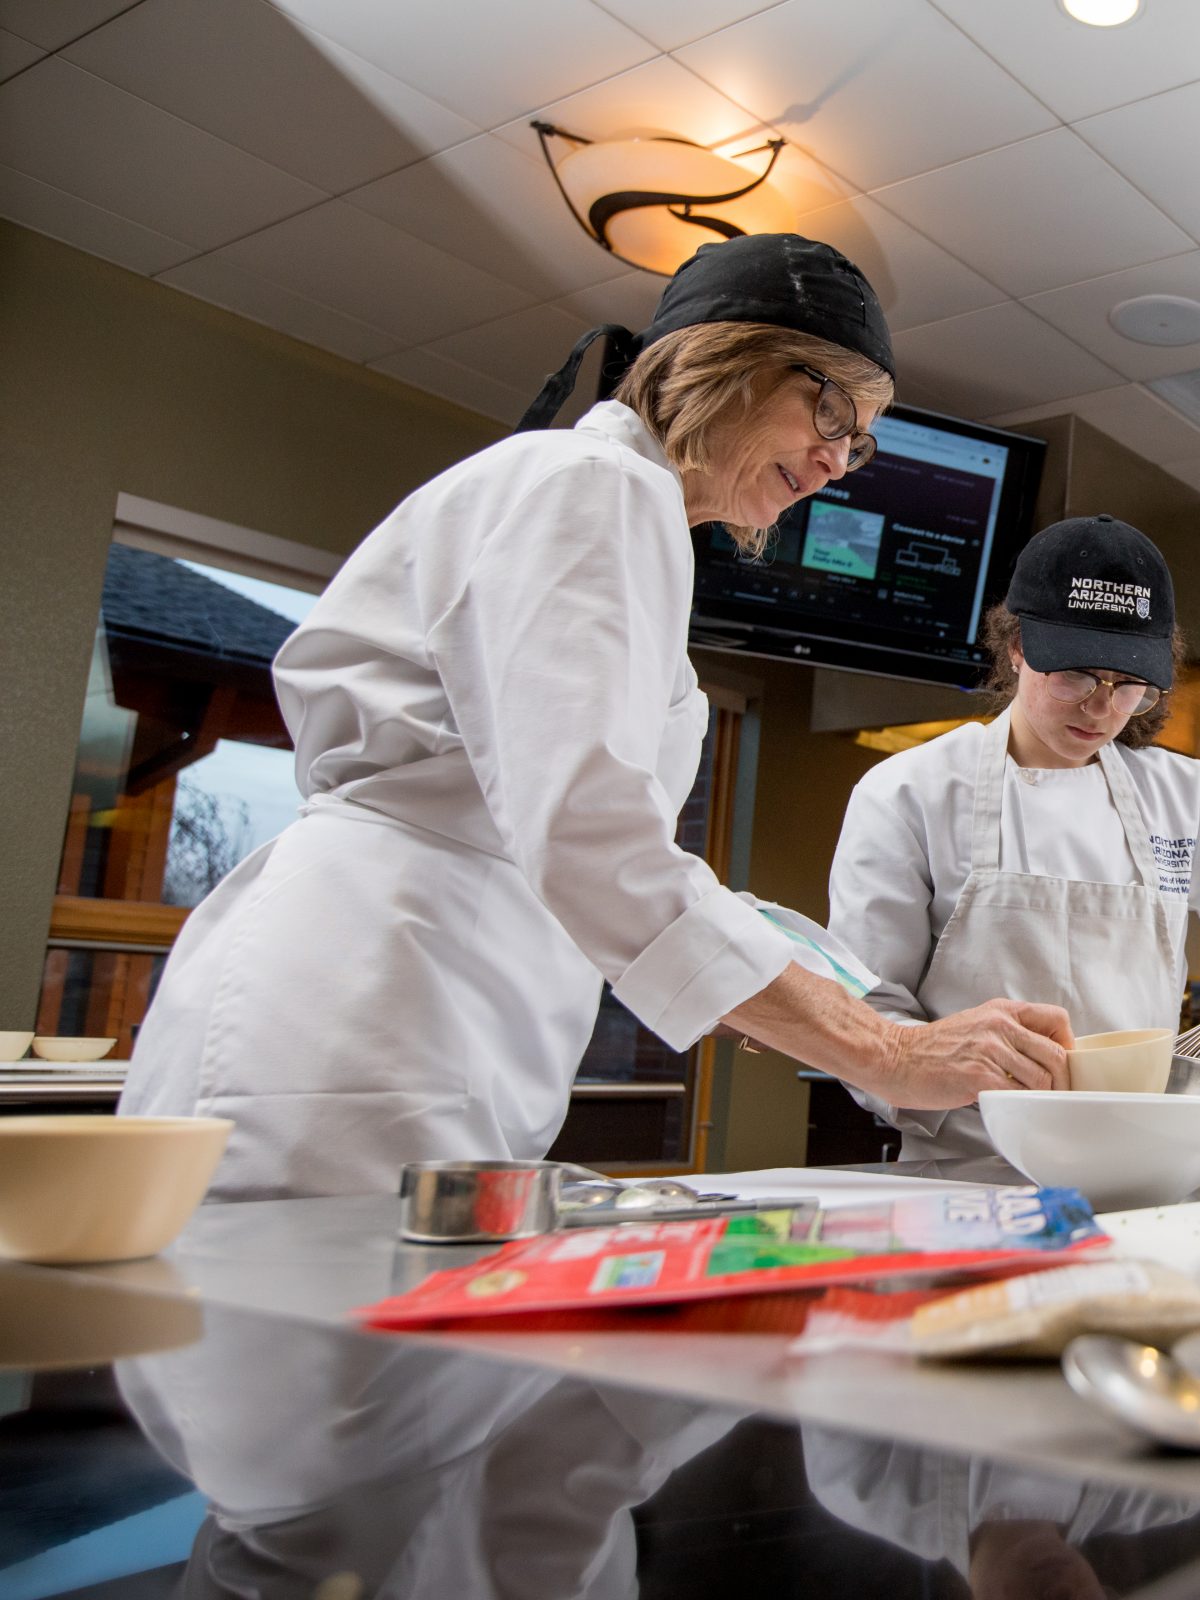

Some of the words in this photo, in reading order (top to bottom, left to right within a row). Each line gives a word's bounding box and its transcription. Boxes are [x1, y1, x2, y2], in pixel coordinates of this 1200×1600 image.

[1071, 577, 1151, 598] NORTHERN
[1067, 599, 1135, 615] UNIVERSITY
[1068, 589, 1136, 607] ARIZONA
